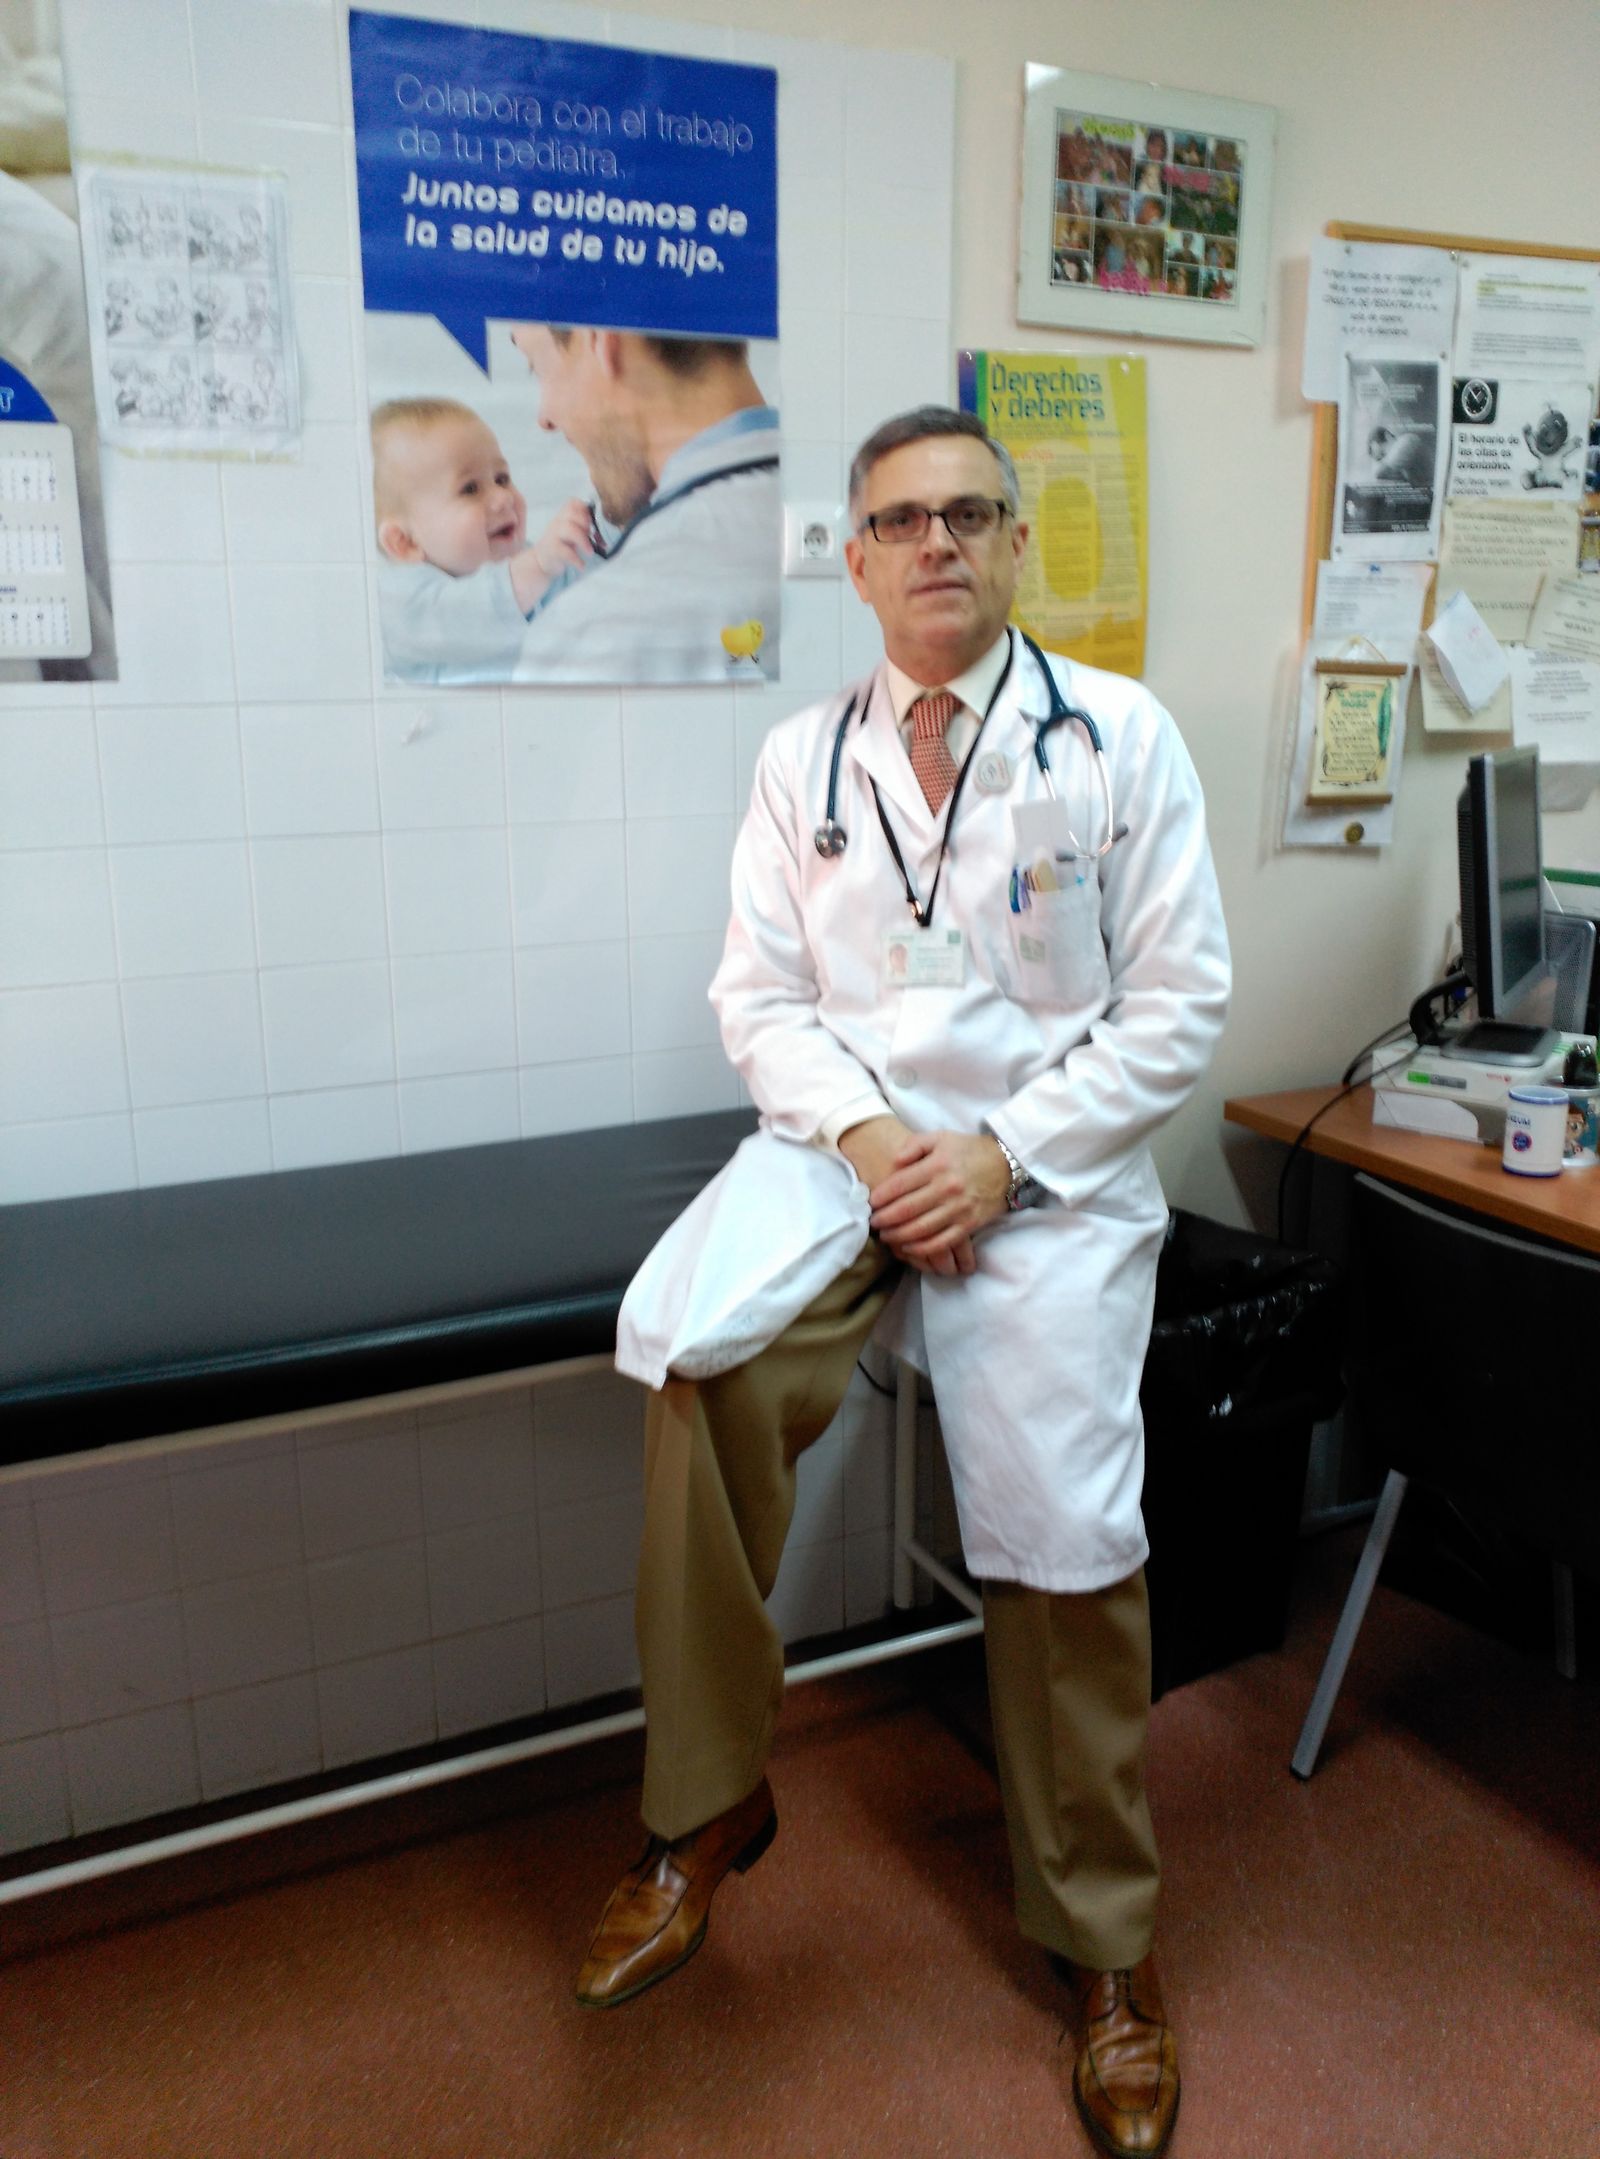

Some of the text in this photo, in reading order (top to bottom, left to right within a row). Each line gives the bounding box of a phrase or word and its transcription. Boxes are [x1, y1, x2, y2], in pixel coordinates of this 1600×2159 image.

[394, 73, 754, 158] Colabora con el trabajo
[397, 124, 441, 160] de
[453, 127, 483, 164] tu
[401, 171, 748, 237] Juntos cuidamos de
[405, 213, 438, 249] la
[451, 221, 550, 258] salud
[561, 228, 603, 262] de
[614, 235, 647, 266] tu
[991, 361, 1104, 394] Derechos
[990, 391, 1106, 422] y deberes
